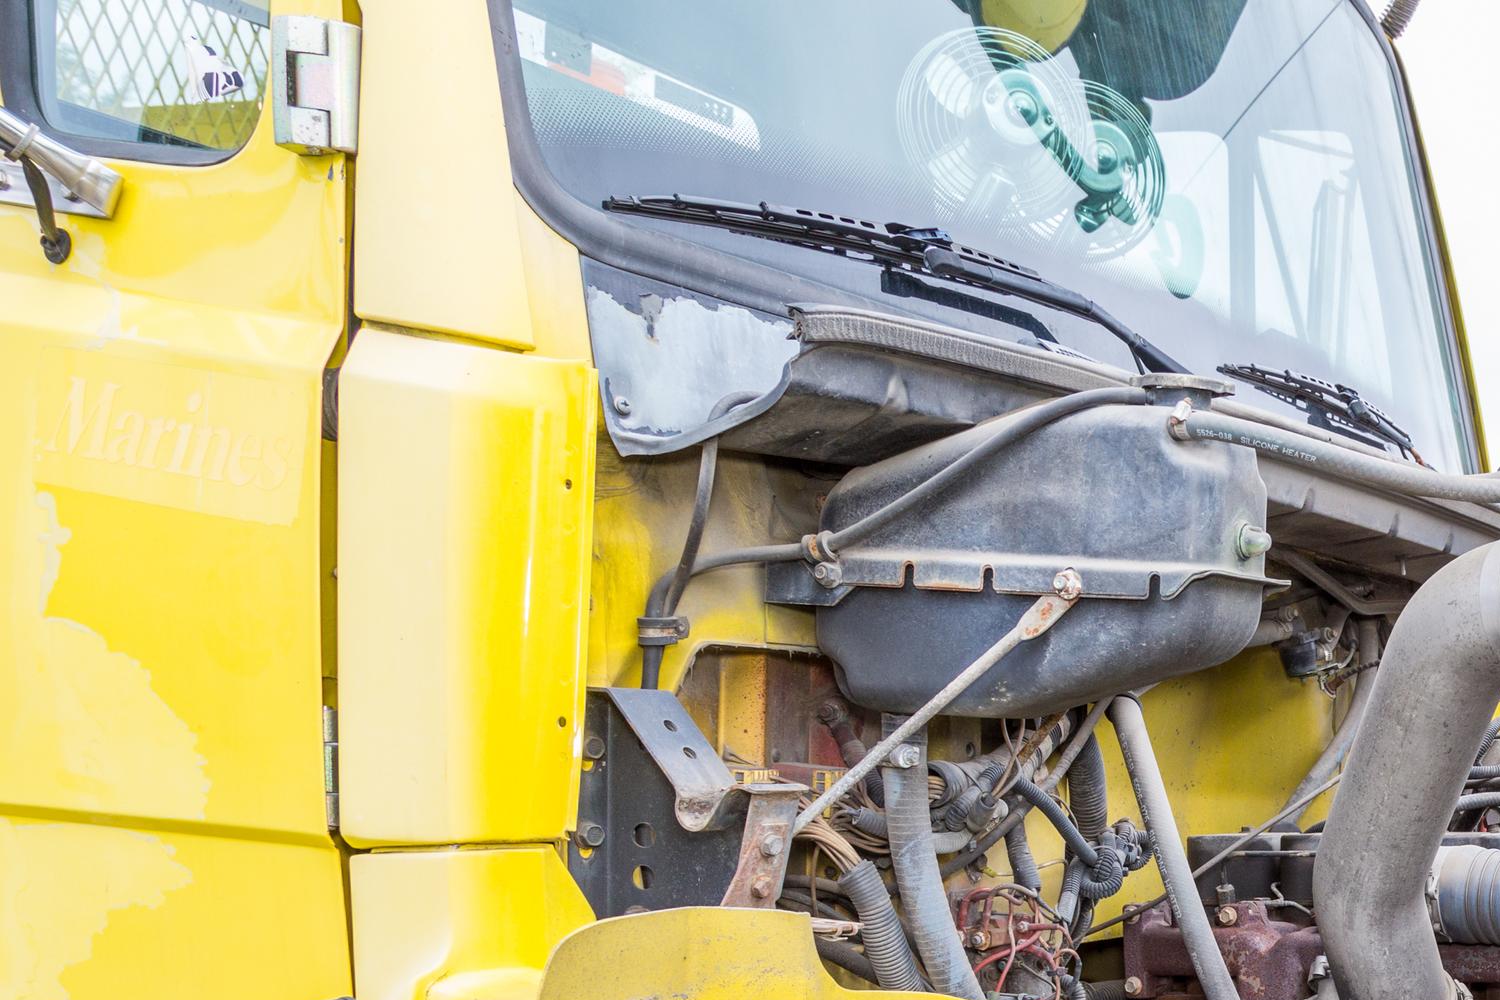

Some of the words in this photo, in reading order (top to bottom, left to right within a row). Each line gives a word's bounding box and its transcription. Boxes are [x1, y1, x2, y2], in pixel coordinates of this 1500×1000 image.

[44, 375, 292, 490] Marines
[1240, 436, 1280, 453] SILICONE
[1282, 447, 1317, 462] HEATER
